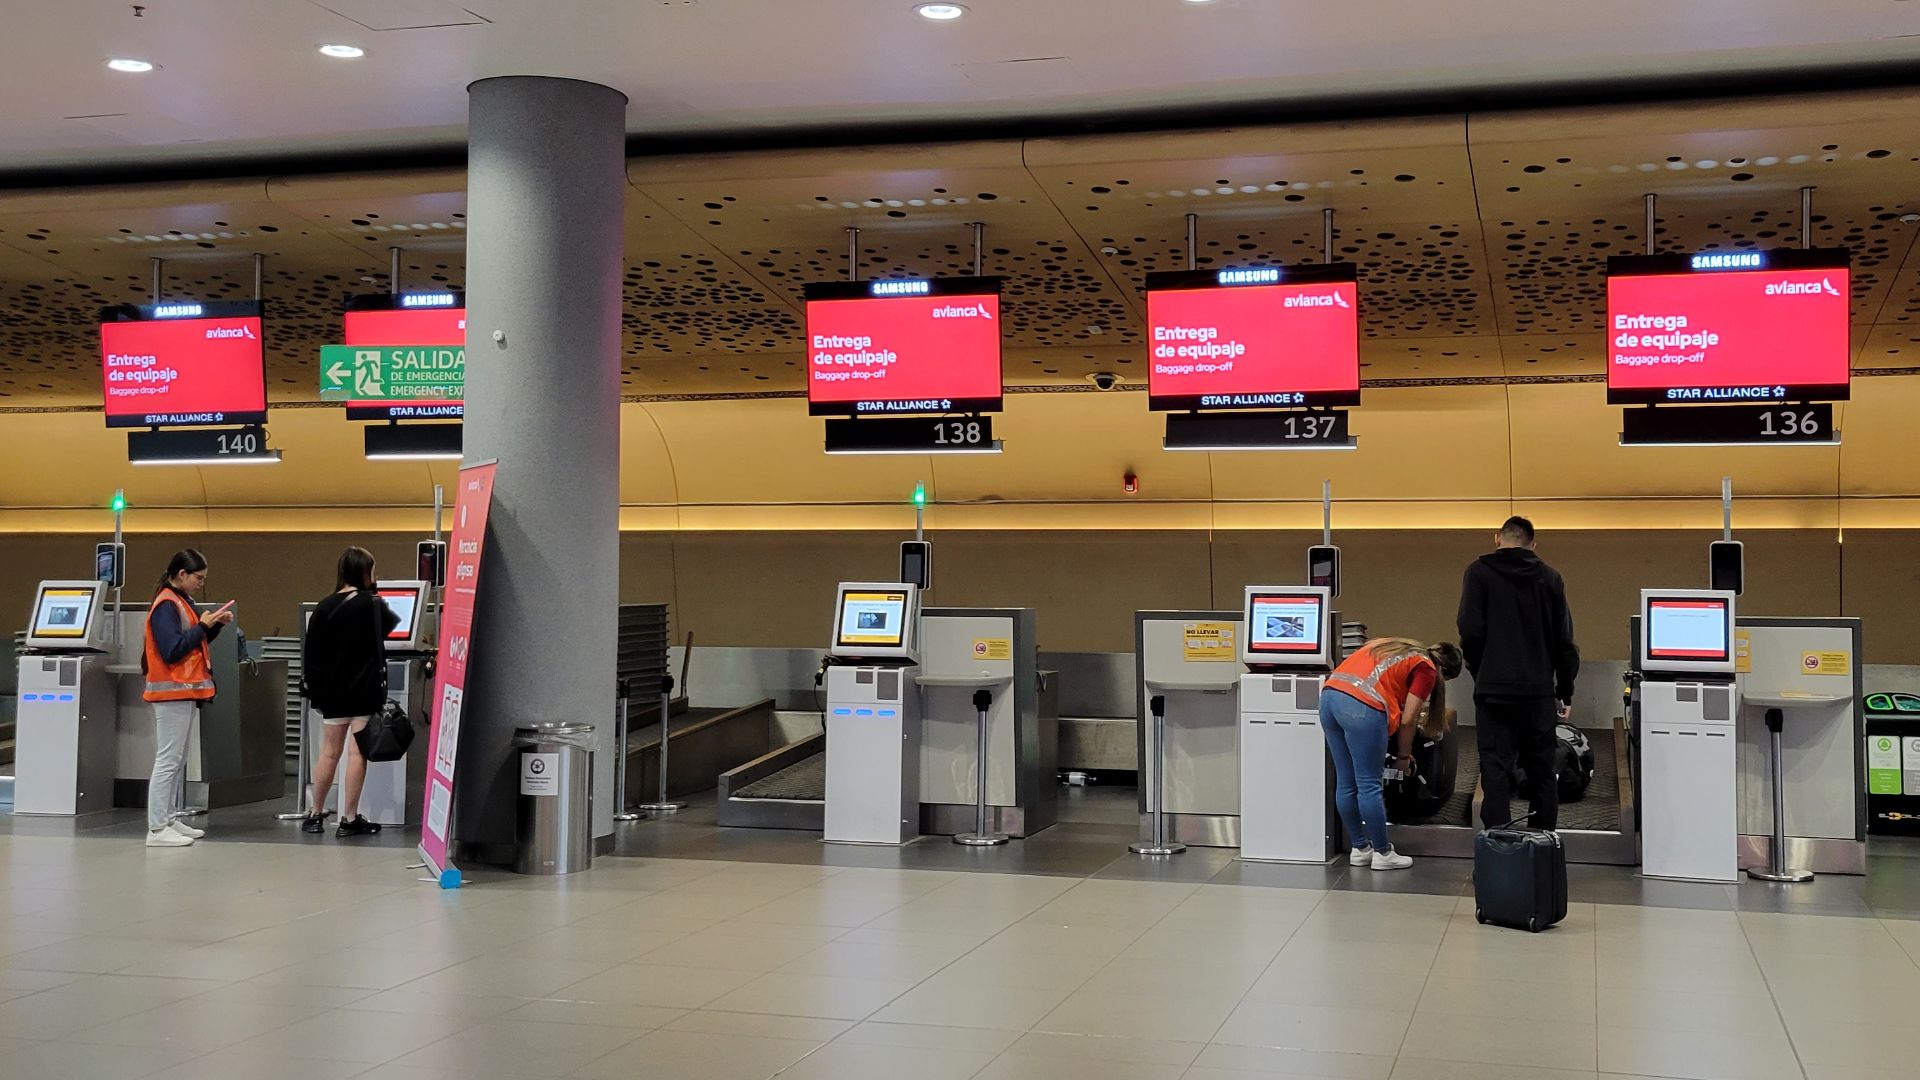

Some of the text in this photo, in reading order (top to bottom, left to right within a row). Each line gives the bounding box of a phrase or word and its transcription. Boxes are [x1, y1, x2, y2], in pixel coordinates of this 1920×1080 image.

[1692, 254, 1760, 268] SAMSUNG
[1218, 269, 1279, 284] SAMSUNG
[873, 281, 929, 295] SAMSUNG
[1765, 280, 1822, 295] avianca
[403, 294, 454, 307] SAMSUNG
[1284, 293, 1334, 308] avianca
[155, 305, 202, 317] SAMSUNG
[932, 305, 978, 318] avianca
[1615, 314, 1688, 331] Entrega
[206, 327, 244, 339] avianca
[1154, 327, 1218, 342] Entrega
[1615, 330, 1719, 350] de equipaje
[813, 335, 872, 351] Entrega
[1155, 341, 1246, 360] de equipaje
[108, 354, 157, 369] Entrega
[391, 350, 465, 370] SALIDA
[814, 349, 897, 367] de equipaje
[1615, 352, 1705, 366] Baggage drop-off
[109, 367, 178, 384] de equipaje
[1155, 362, 1234, 375] Baggage drop-off
[391, 372, 403, 381] DE
[814, 370, 886, 382] Baggage drop-off
[109, 385, 169, 396] Baggage drop-off
[390, 385, 465, 396] EMERGENCY EXI
[1667, 387, 1770, 399] STAR ALLIANCE
[857, 400, 939, 411] STAR ALLIANCE
[1201, 394, 1291, 406] STAR ALLIANCE
[145, 413, 214, 423] STAR ALLIANCE
[389, 406, 463, 416] STAR ALLIANCE
[1284, 416, 1336, 439] 137
[1759, 411, 1819, 435] 136
[933, 422, 981, 444] 138
[217, 434, 257, 454] 140
